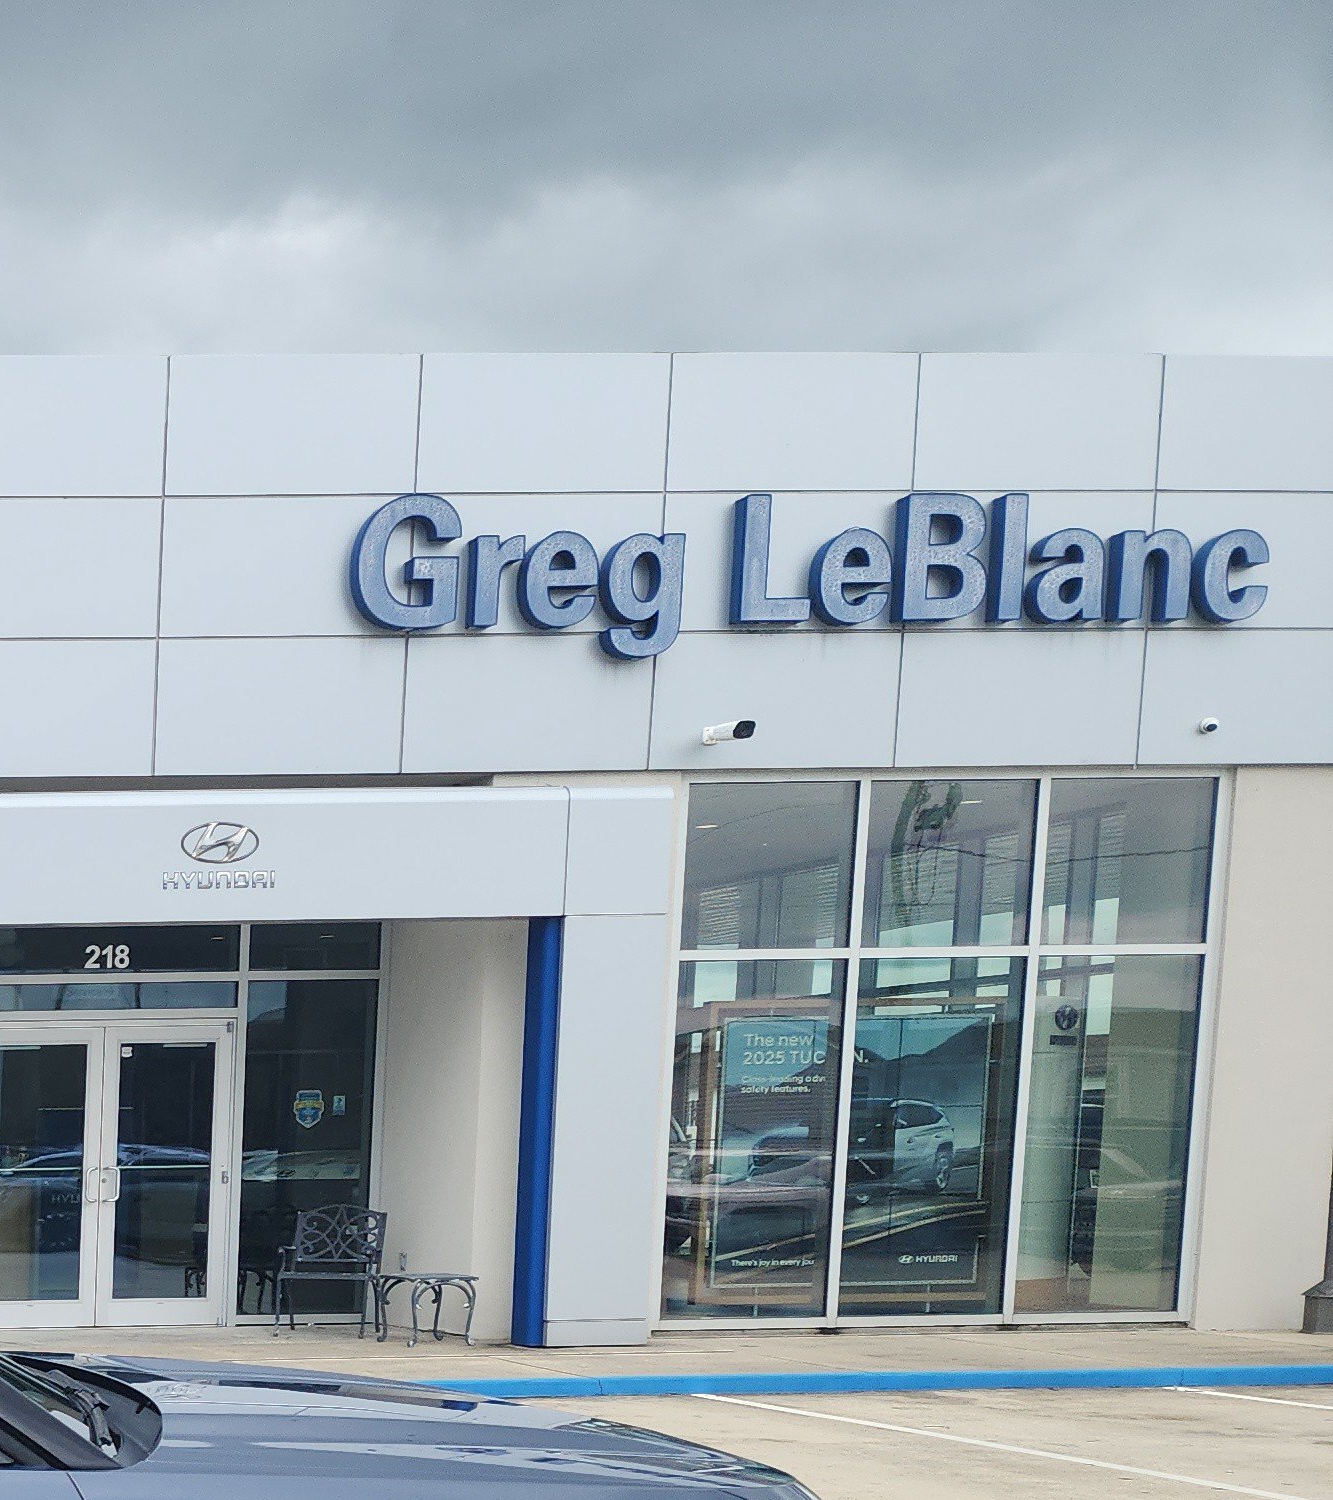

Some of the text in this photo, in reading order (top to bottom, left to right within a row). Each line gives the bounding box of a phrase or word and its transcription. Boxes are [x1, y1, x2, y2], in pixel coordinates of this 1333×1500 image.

[350, 492, 1270, 661] Greg LeBlanc
[162, 870, 276, 890] HYUNDAI
[84, 944, 131, 971] 218
[743, 1033, 814, 1046] The new
[743, 1051, 785, 1065] 2025
[915, 1254, 958, 1263] HYUNDAI
